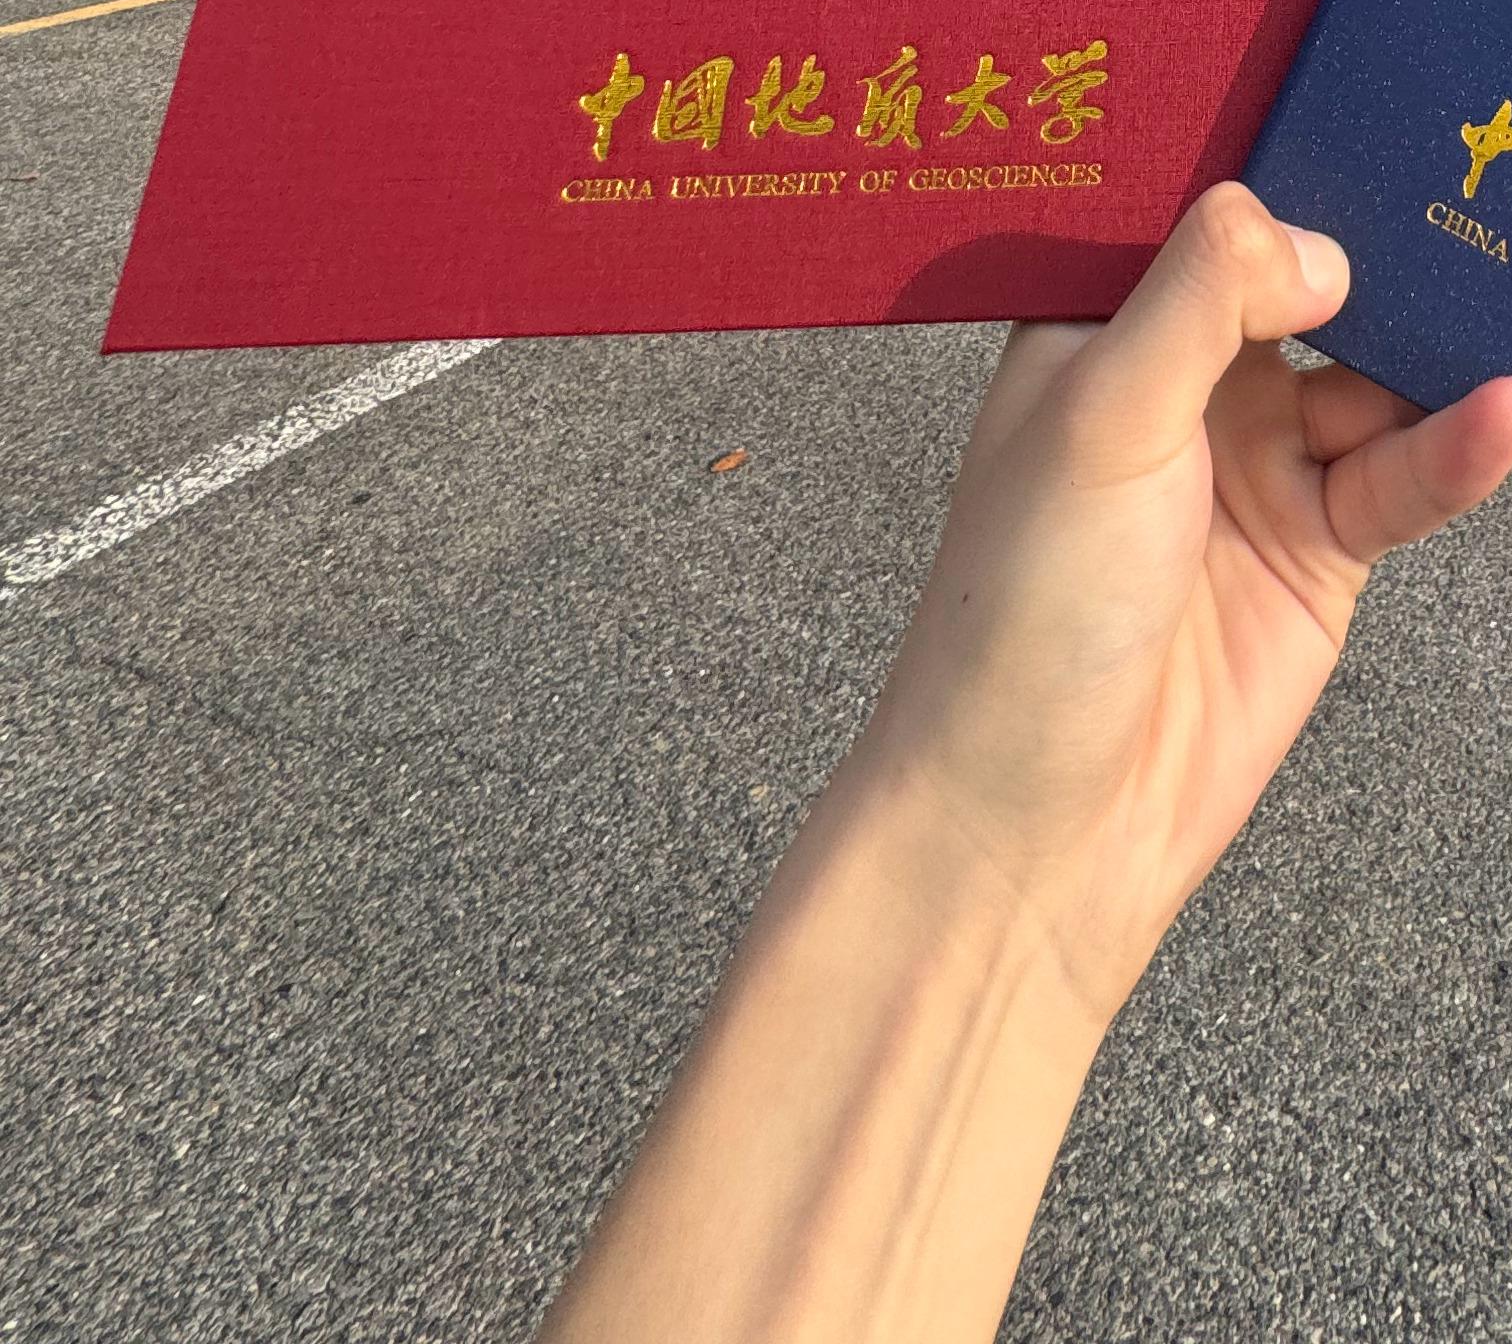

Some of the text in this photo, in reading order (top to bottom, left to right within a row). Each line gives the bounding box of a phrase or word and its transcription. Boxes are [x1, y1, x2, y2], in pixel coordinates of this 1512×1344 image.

[561, 162, 1103, 203] CHINA UNIVERSITY OF GEOSCIENCES
[1425, 201, 1509, 264] CHINA
